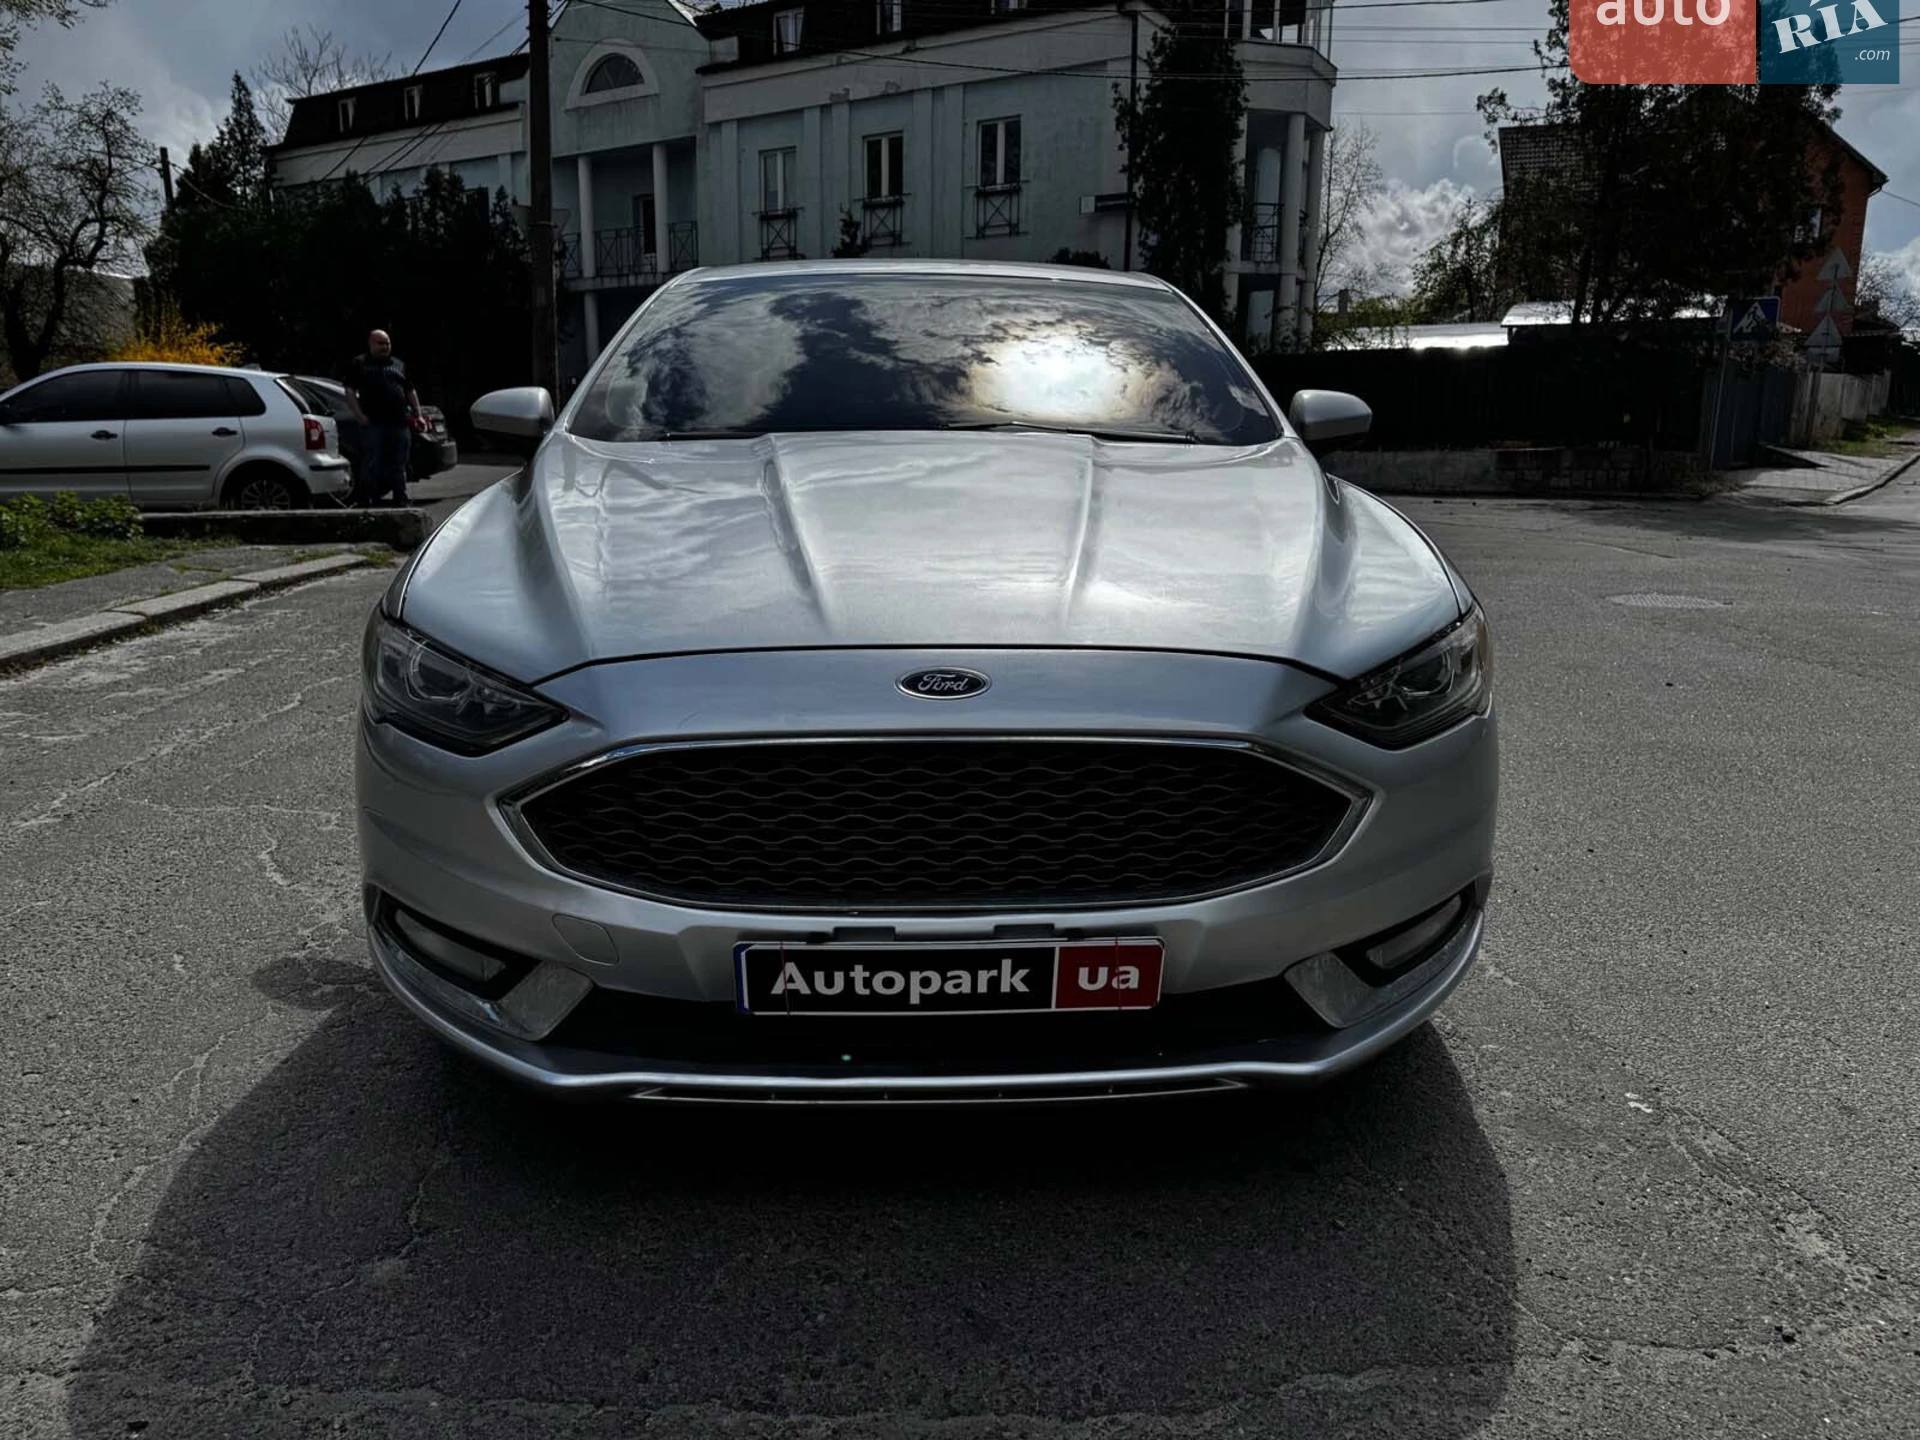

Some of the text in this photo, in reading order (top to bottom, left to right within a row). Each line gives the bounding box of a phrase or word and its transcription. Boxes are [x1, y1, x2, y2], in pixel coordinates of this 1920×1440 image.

[917, 673, 969, 692] Ford
[770, 959, 1141, 1005] Autopark ua
